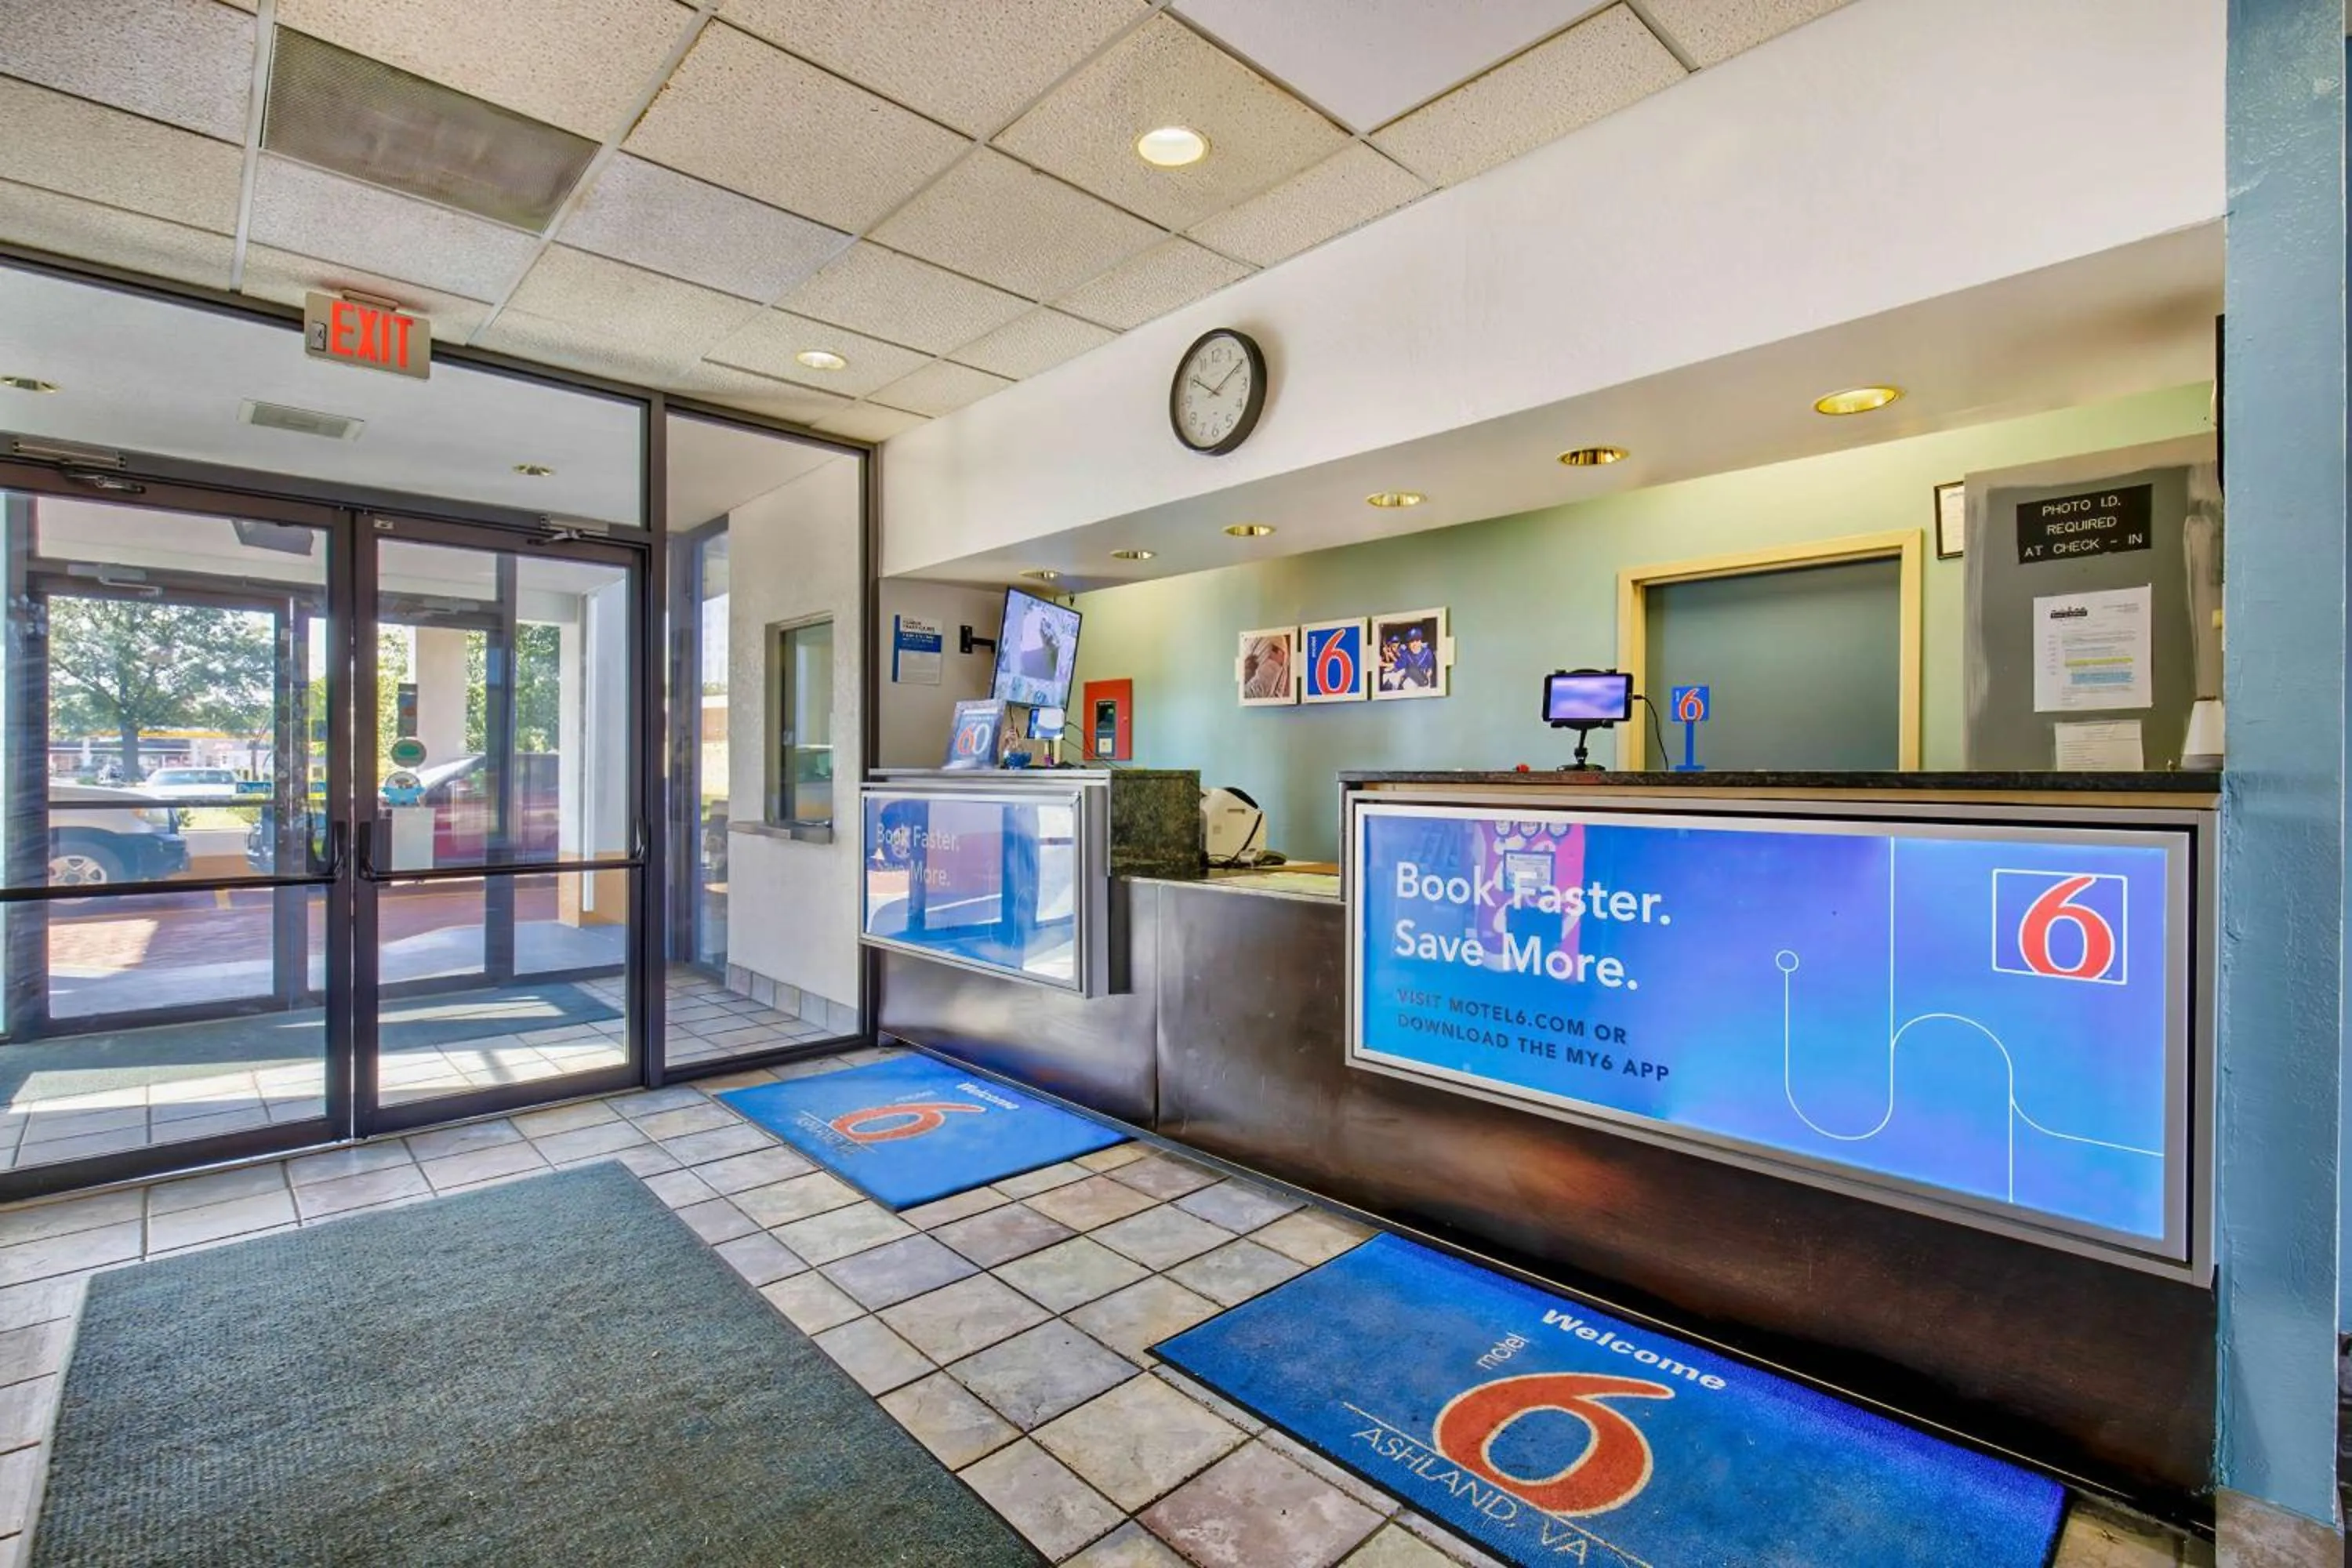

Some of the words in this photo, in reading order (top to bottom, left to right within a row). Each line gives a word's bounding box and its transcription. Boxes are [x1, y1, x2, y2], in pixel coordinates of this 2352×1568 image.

[330, 300, 414, 369] EXIT
[1211, 348, 1221, 363] 12
[1228, 349, 1232, 362] 1
[1242, 377, 1248, 392] 3
[1189, 412, 1197, 426] 8
[1235, 397, 1243, 412] 4
[1200, 422, 1207, 437] 7
[1211, 423, 1219, 437] 6
[1225, 413, 1233, 429] 5
[2042, 499, 2092, 517] PHOTO
[2046, 516, 2118, 535] REQUIRED
[2024, 545, 2044, 557] AT
[2053, 538, 2100, 555] CHECK
[2128, 532, 2143, 546] IN
[1316, 628, 1354, 696] 6
[1679, 688, 1704, 722] 6
[913, 825, 960, 852] Faster.
[910, 859, 951, 887] More.
[1396, 861, 1496, 907] Book
[1513, 870, 1671, 925] Faster.
[2018, 874, 2115, 982] 6
[1395, 919, 1484, 967] Save
[1502, 932, 1639, 990] More.
[1396, 989, 1442, 1009] VISIT
[1449, 996, 1585, 1038] MOTEL6.COM
[1595, 1024, 1627, 1045] OR
[1398, 1014, 1509, 1049] DOWNLOAD
[1518, 1036, 1557, 1059] THE
[1566, 1047, 1613, 1071] MY6
[1622, 1060, 1670, 1081] APP
[829, 1102, 985, 1143] 6
[1475, 1332, 1530, 1370] motel
[1540, 1308, 1727, 1391] Welcome
[1433, 1372, 1675, 1518] 6
[1352, 1427, 1519, 1529] ASHLAND,
[1539, 1517, 1592, 1565] VA
